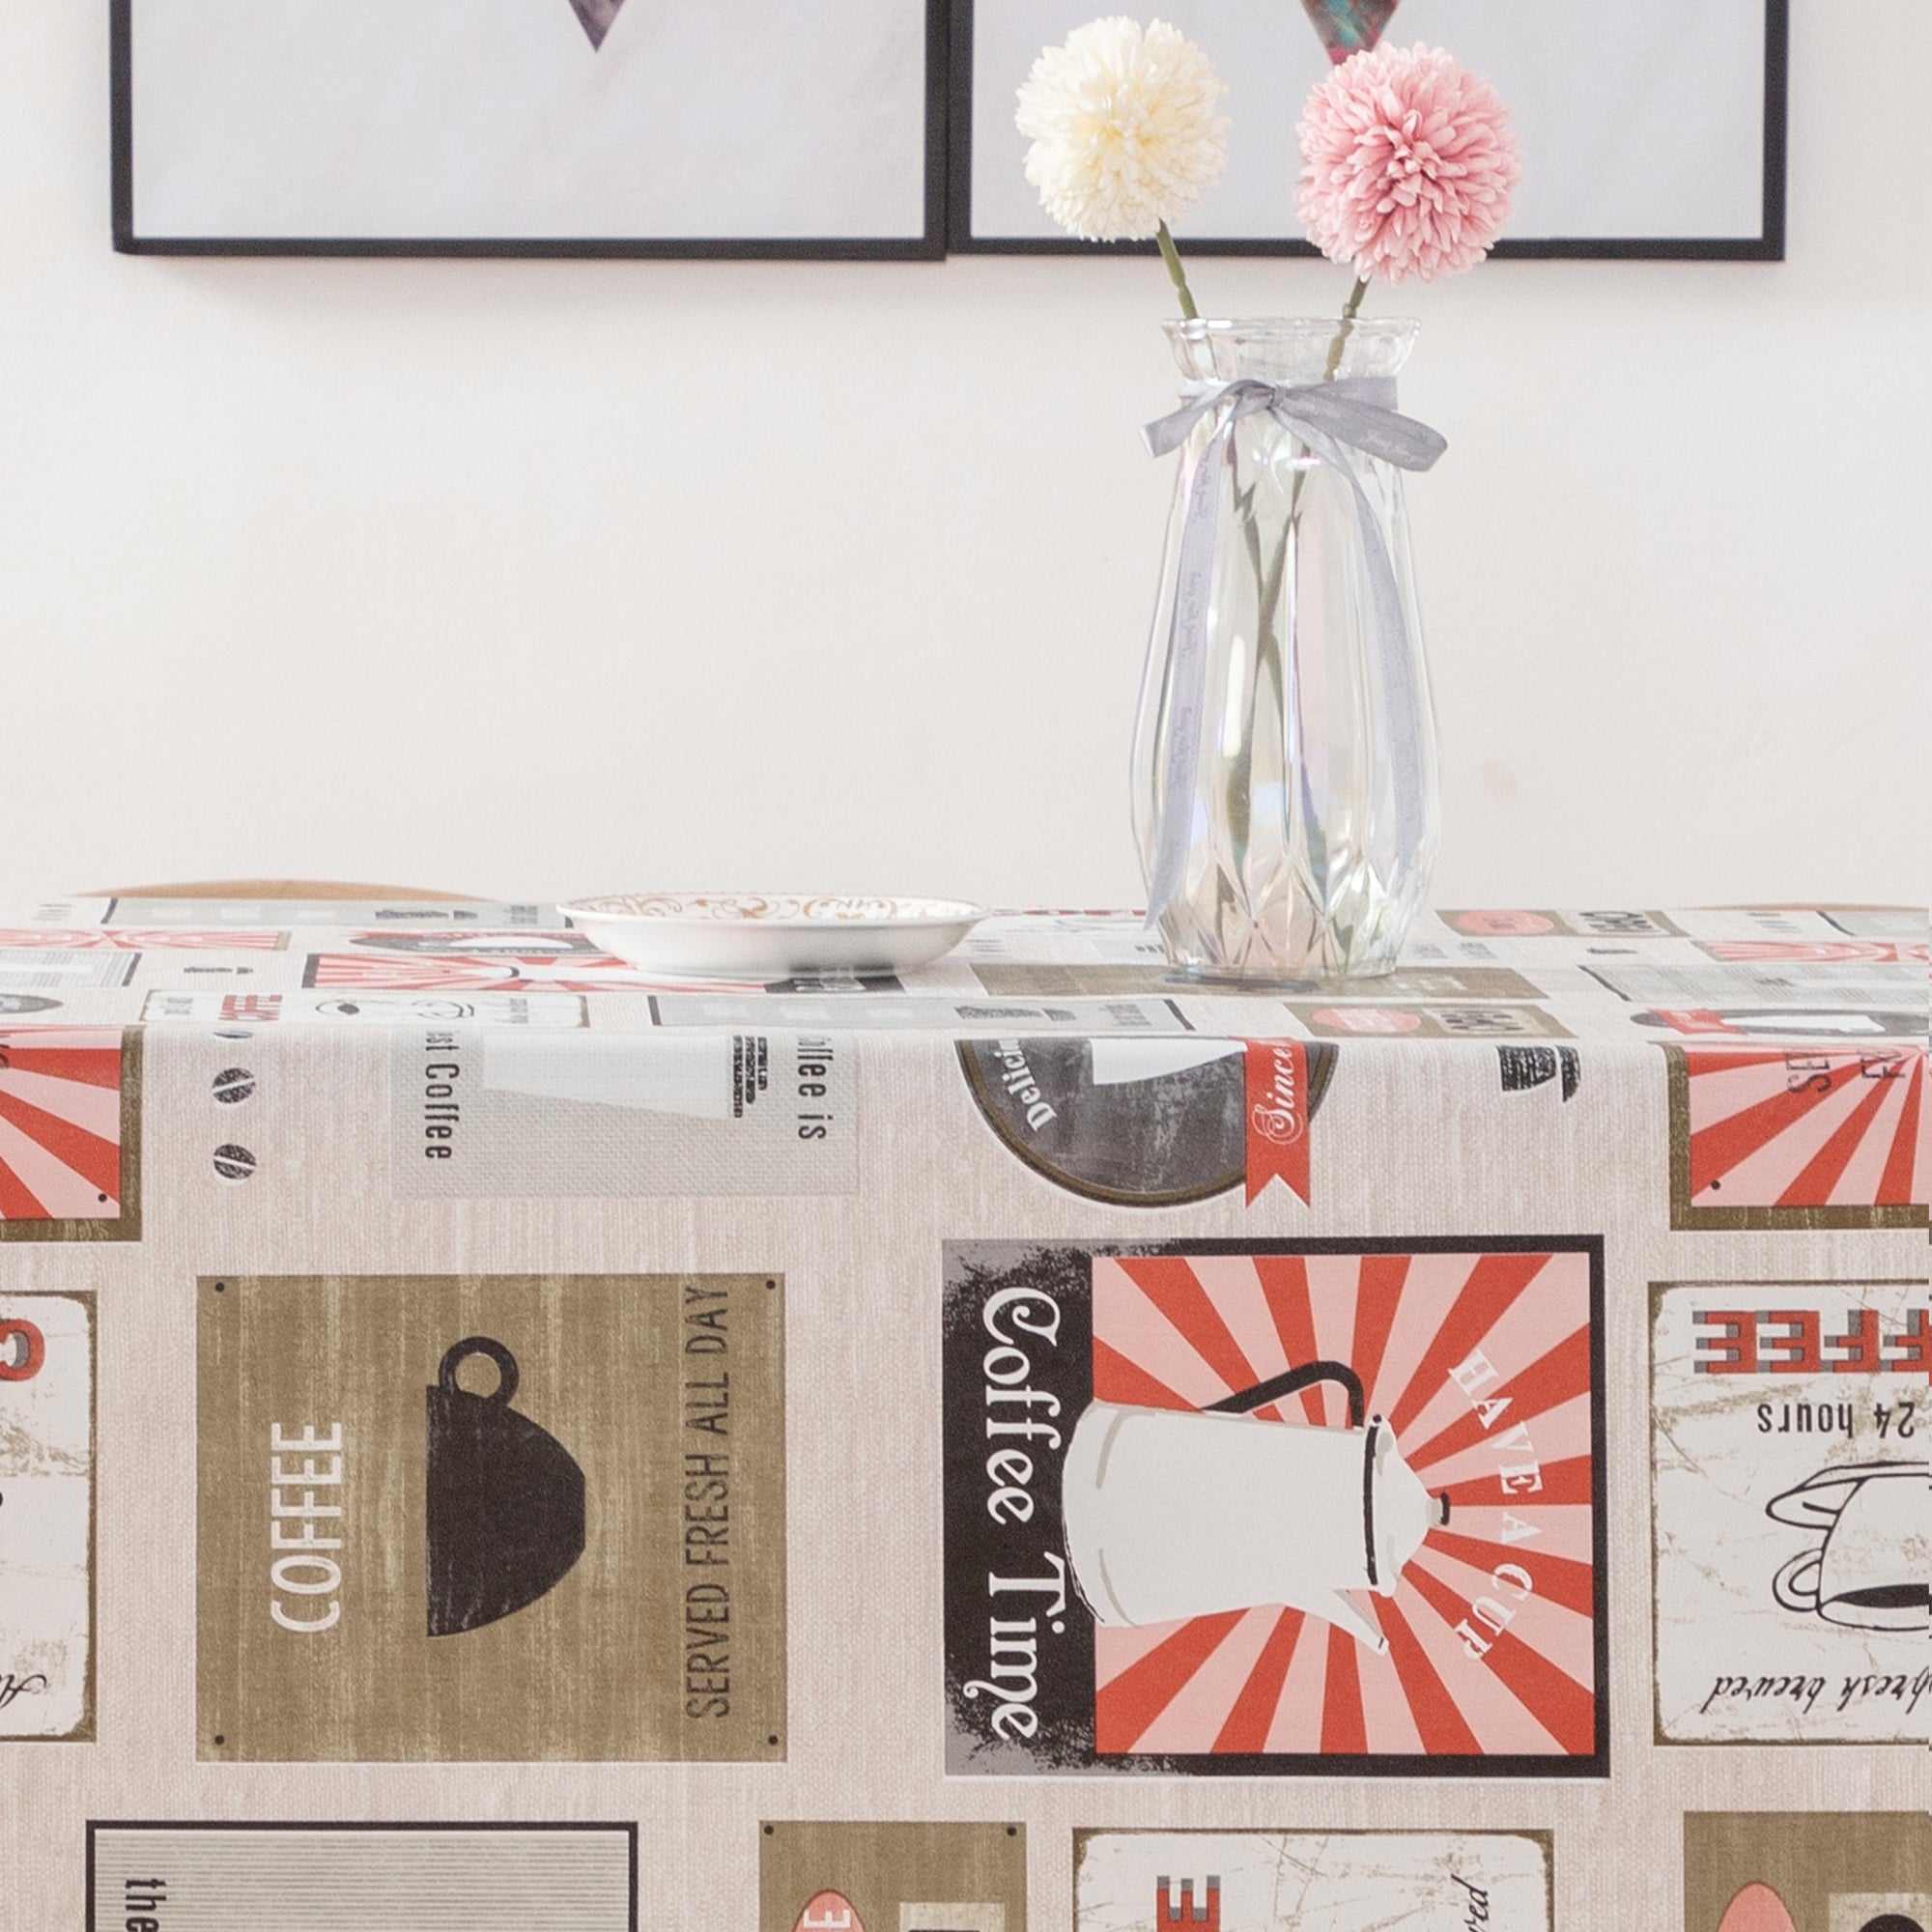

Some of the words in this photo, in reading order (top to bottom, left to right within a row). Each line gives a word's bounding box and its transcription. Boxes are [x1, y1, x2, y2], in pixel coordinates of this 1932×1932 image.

[424, 1064, 460, 1159] Coffee
[797, 1114, 834, 1140] is
[1251, 1047, 1303, 1145] Since
[685, 1286, 729, 1356] DAY
[685, 1371, 729, 1435] ALL
[981, 1286, 1062, 1526] Coffee
[1447, 1348, 1544, 1494] HAVE
[1756, 1402, 1854, 1439] hours
[1874, 1401, 1917, 1439] 24
[270, 1422, 342, 1633] COFFEE
[685, 1453, 730, 1566] FRESH
[1501, 1511, 1544, 1544] A
[685, 1582, 731, 1720] SERVED
[962, 1551, 1066, 1740] Time
[1453, 1562, 1534, 1660] CUP
[1698, 1674, 1826, 1715] brewed
